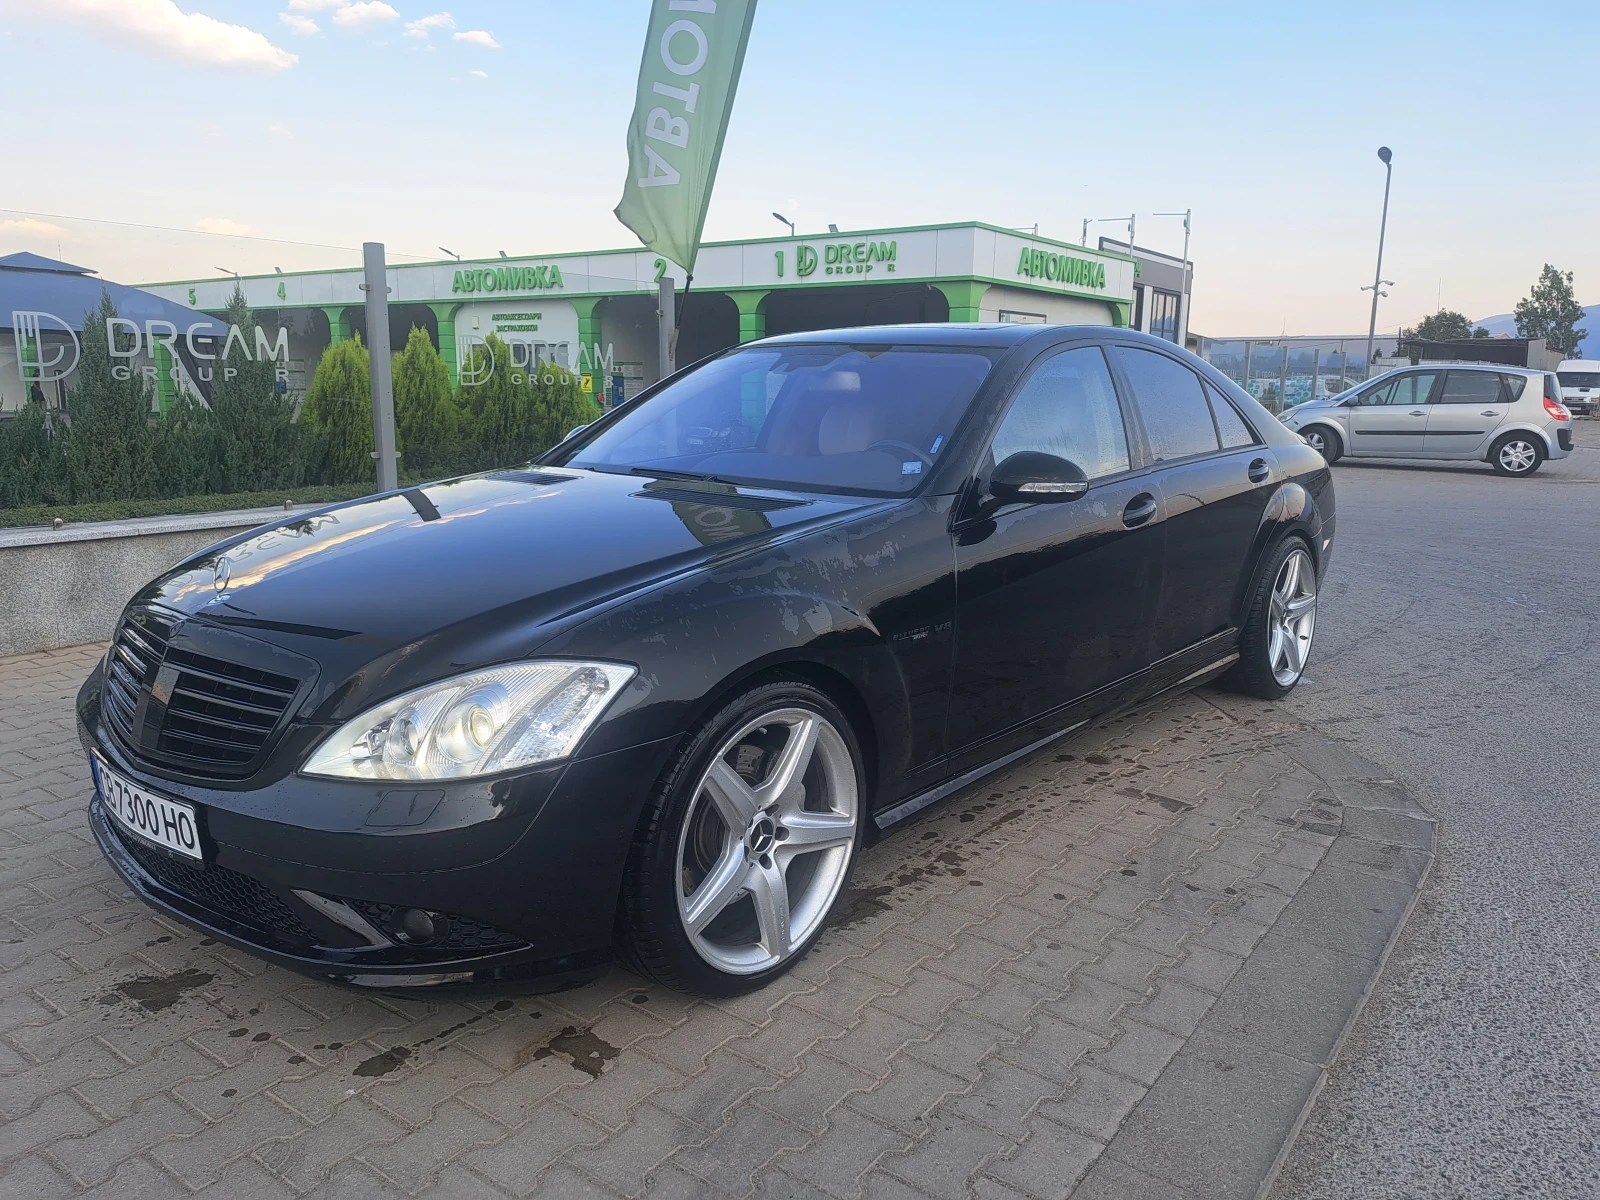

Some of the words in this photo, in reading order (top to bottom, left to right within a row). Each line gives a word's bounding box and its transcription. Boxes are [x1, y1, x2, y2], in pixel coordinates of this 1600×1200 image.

[824, 241, 897, 263] DREAM
[452, 264, 564, 293] АВТОМИВКА
[654, 258, 667, 283] 2
[825, 265, 873, 275] GROUP
[887, 264, 896, 272] R
[1017, 247, 1107, 289] АВТОМИВКА
[188, 288, 197, 305] 5
[277, 282, 286, 300] 4
[106, 317, 290, 362] DREAM
[509, 338, 614, 370] DREAM
[111, 365, 238, 382] GROUP
[275, 368, 290, 382] R
